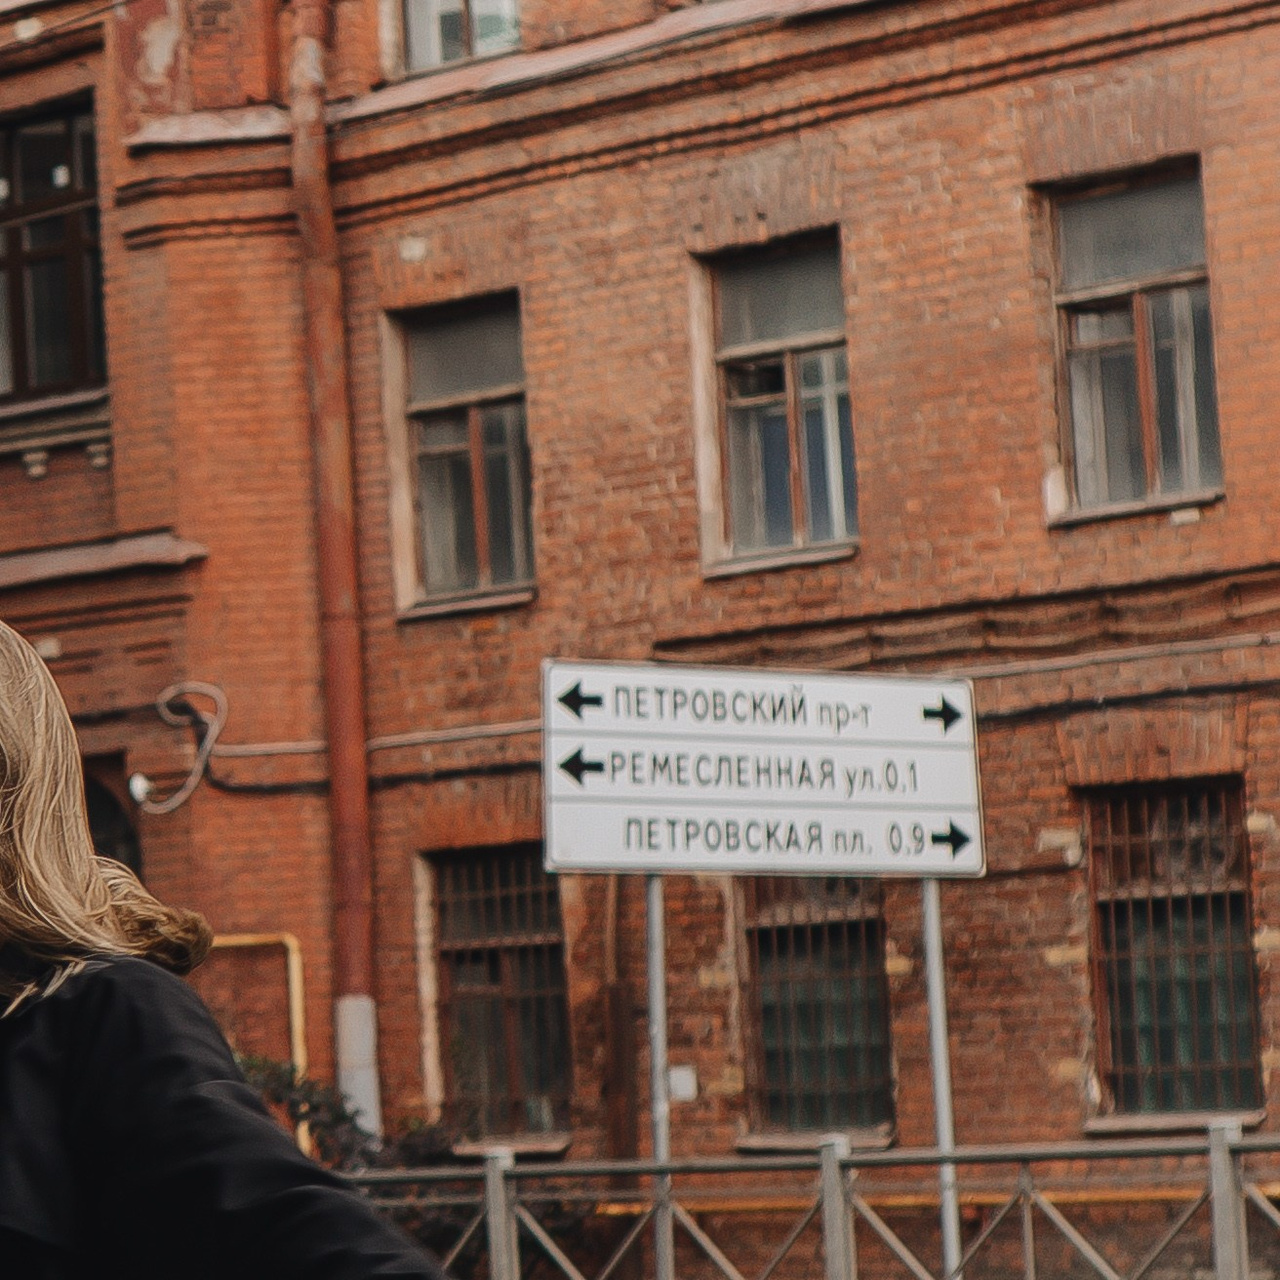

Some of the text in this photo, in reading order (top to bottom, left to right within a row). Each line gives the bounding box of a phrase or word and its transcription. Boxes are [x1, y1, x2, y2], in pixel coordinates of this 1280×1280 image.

[614, 685, 872, 734] ПЕТРОВСКИЙ пр-т
[610, 751, 835, 789] РЕМЕСЛЕННАЯ
[626, 818, 823, 853] ПЕТРОВСКАЯ
[834, 829, 872, 854] пл.
